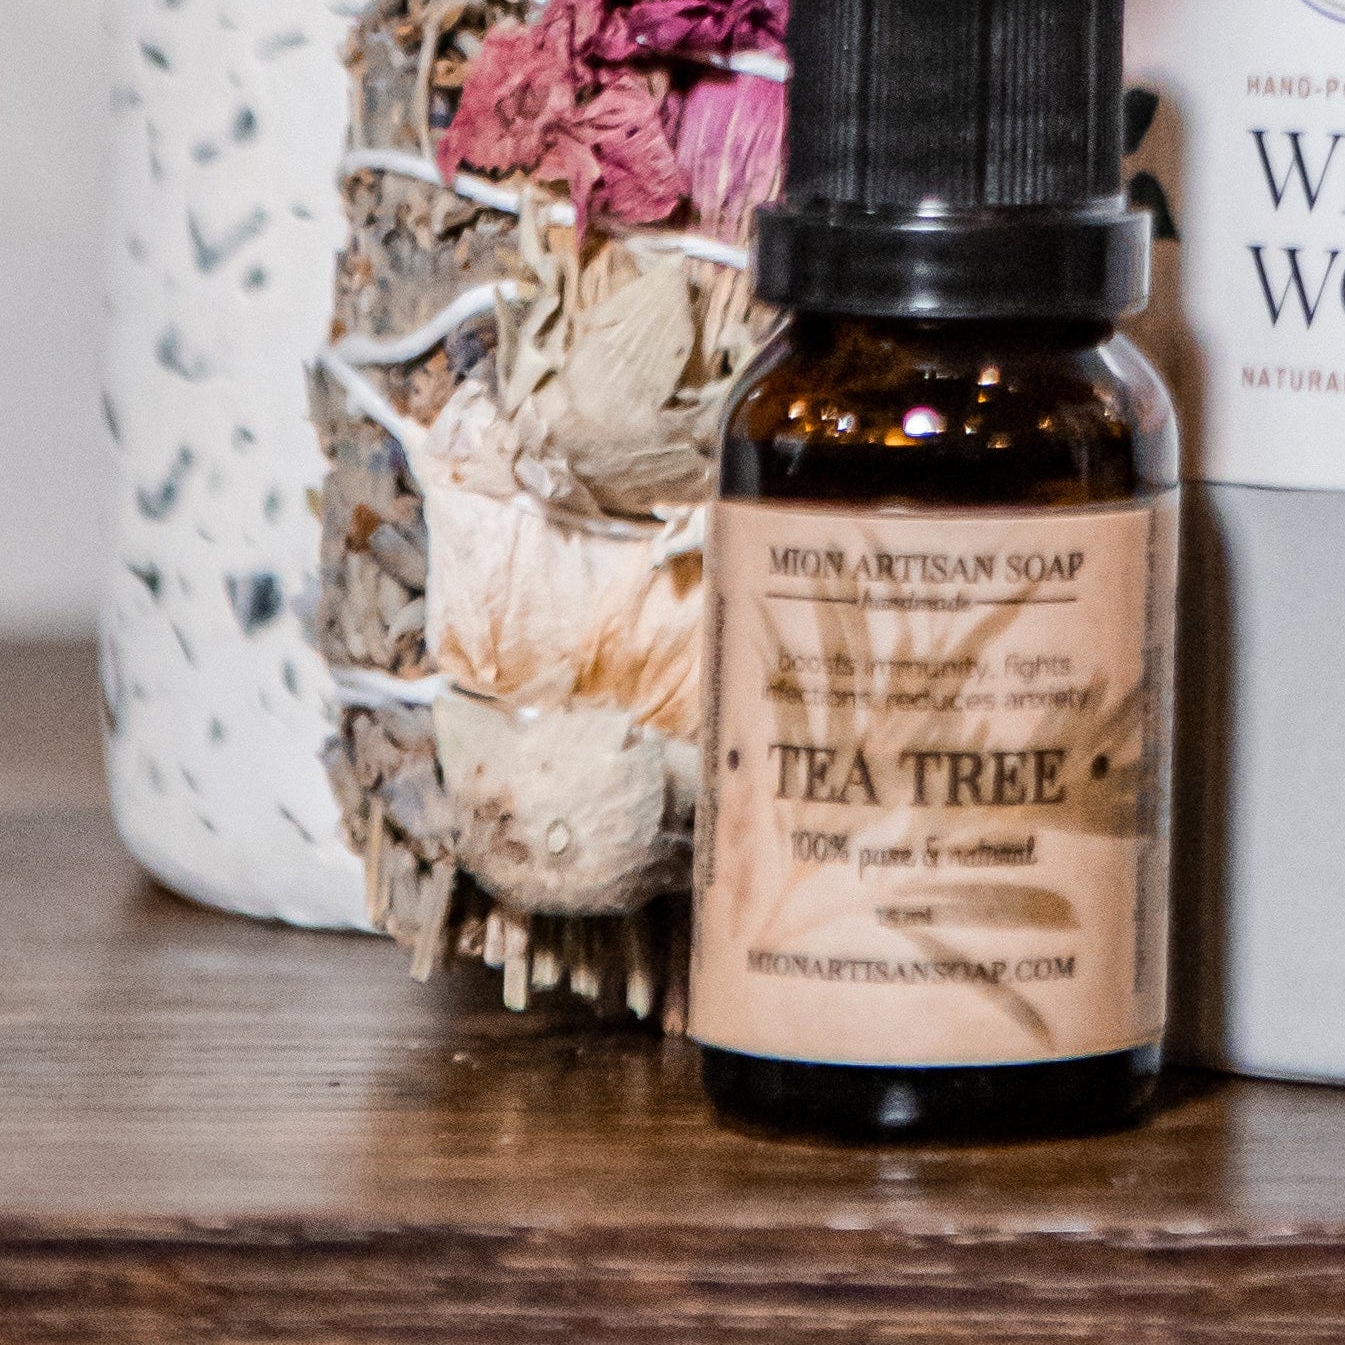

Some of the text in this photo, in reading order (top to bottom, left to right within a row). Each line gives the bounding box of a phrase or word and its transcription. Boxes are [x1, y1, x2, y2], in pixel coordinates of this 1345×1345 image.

[769, 546, 1084, 584] MION ARTISAN SOAP
[769, 743, 1067, 806] TEA TREE
[790, 830, 850, 862] 100%
